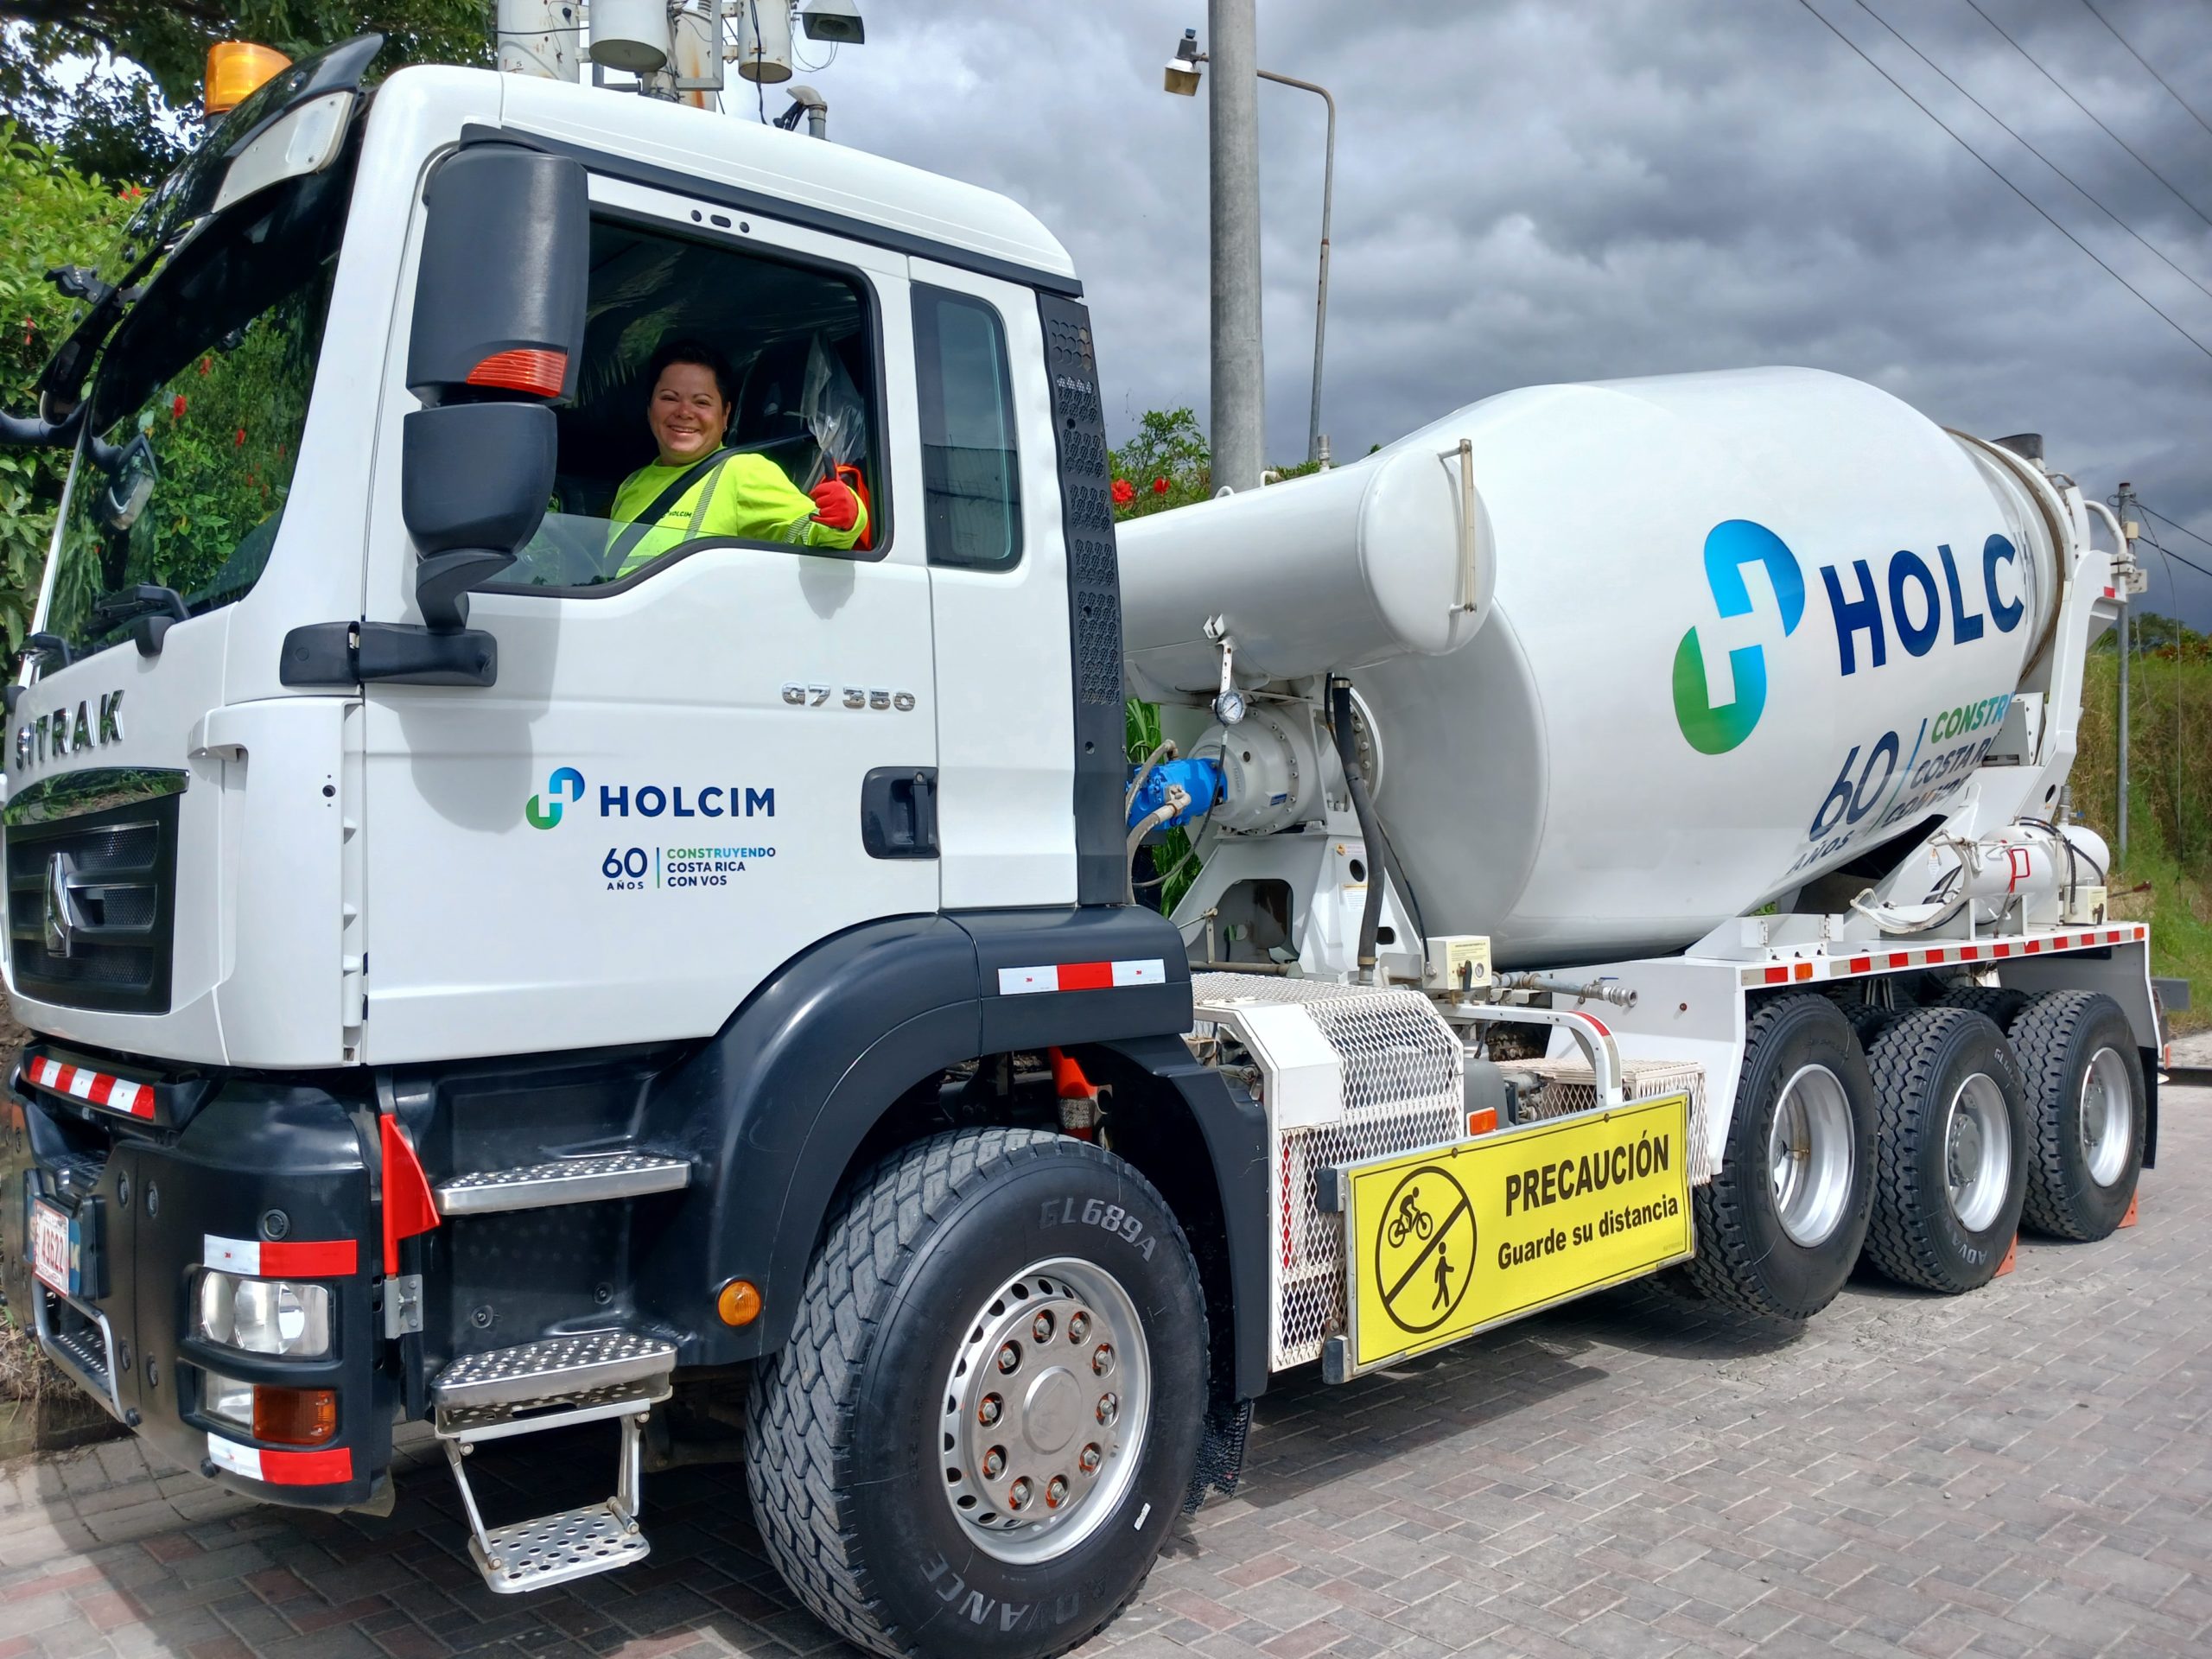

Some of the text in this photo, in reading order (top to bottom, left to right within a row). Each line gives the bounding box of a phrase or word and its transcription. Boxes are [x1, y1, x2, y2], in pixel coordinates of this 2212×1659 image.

[781, 681, 916, 712] G7 350
[16, 690, 125, 771] SITRAK
[1910, 742, 1976, 790] COSTA
[600, 785, 775, 817] HOLCIM
[1809, 730, 1899, 842] 60
[601, 847, 648, 879] 60
[666, 847, 776, 860] CONSTRUYENDO
[667, 861, 746, 873] COSTA RICA
[607, 880, 644, 891] AÑOS
[667, 874, 728, 887] CON VOS
[1505, 1129, 1669, 1217] PRECAUCIÓN
[1039, 1197, 1156, 1262] GL689A
[1497, 1193, 1679, 1270] Guarde su distancia
